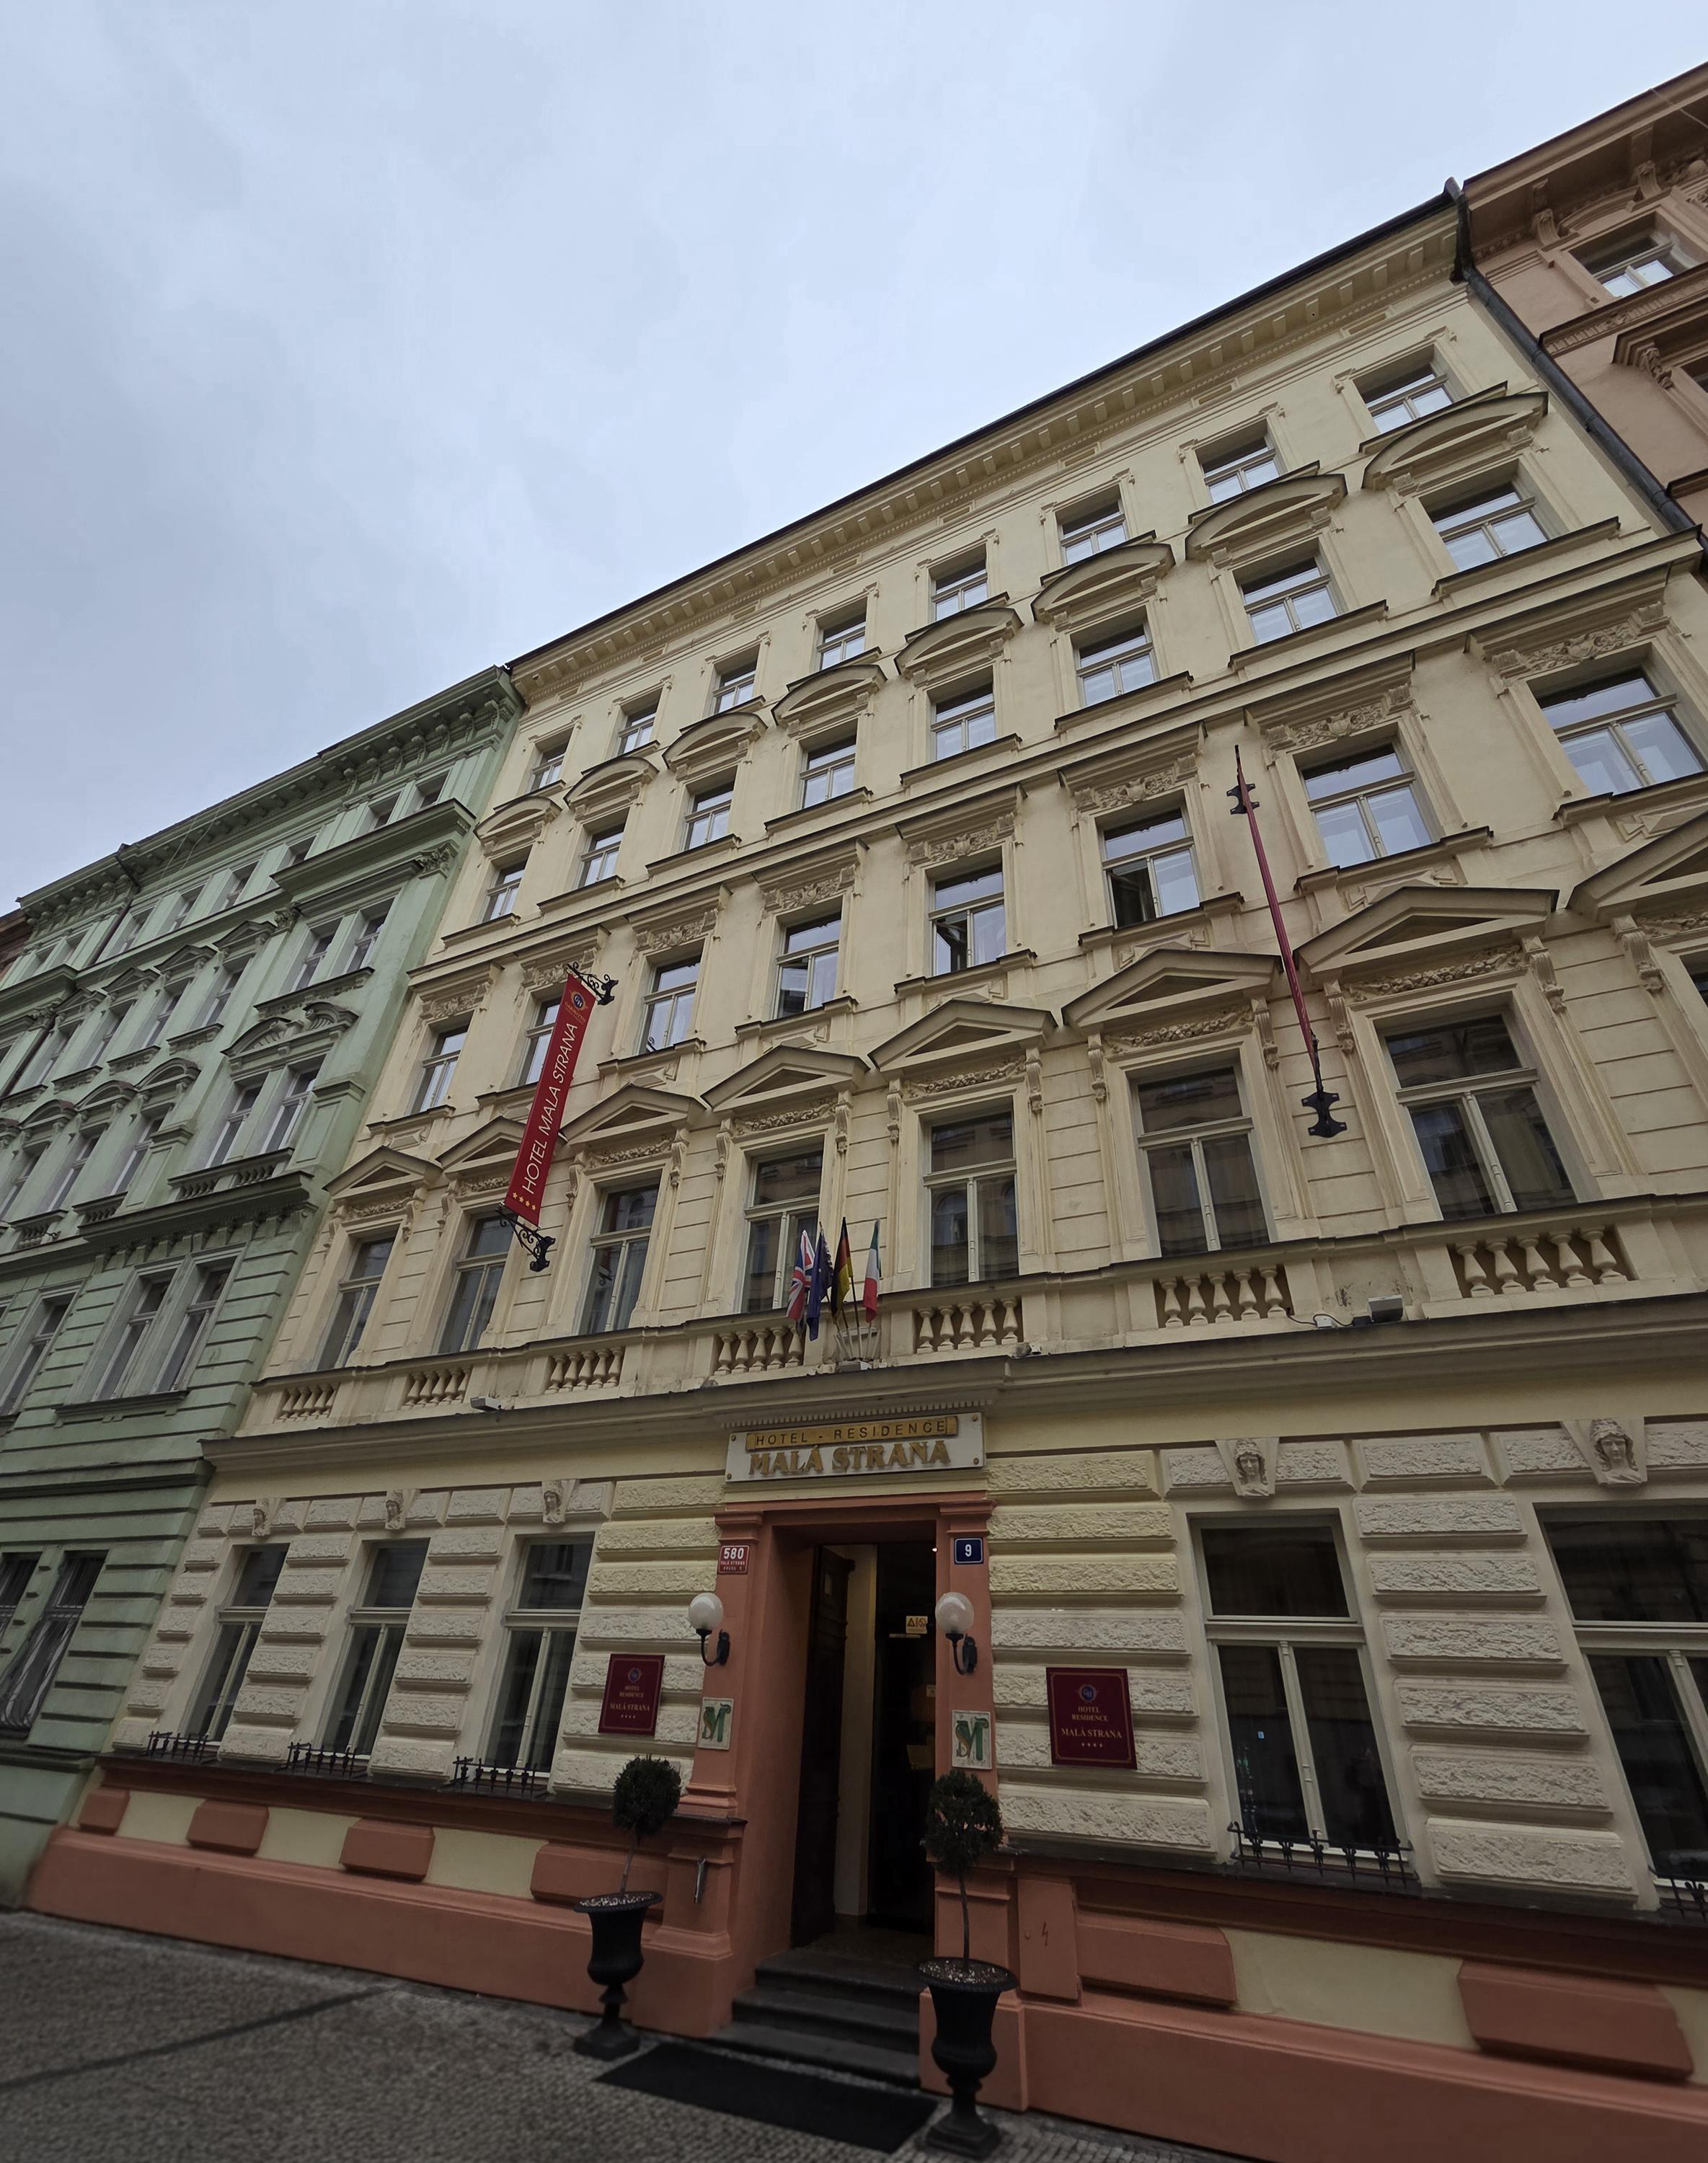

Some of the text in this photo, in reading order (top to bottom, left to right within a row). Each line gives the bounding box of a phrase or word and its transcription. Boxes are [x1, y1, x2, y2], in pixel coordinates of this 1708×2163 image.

[521, 1139, 548, 1195] HOTEL
[552, 1023, 578, 1083] STRANA
[756, 1431, 808, 1446] HOTEL
[833, 1420, 945, 1440] RESIDENCE
[748, 1440, 952, 1477] MALÁ STRANA
[723, 1547, 745, 1560] 580
[965, 1544, 973, 1557] 9
[1087, 1728, 1123, 1739] STRANA
